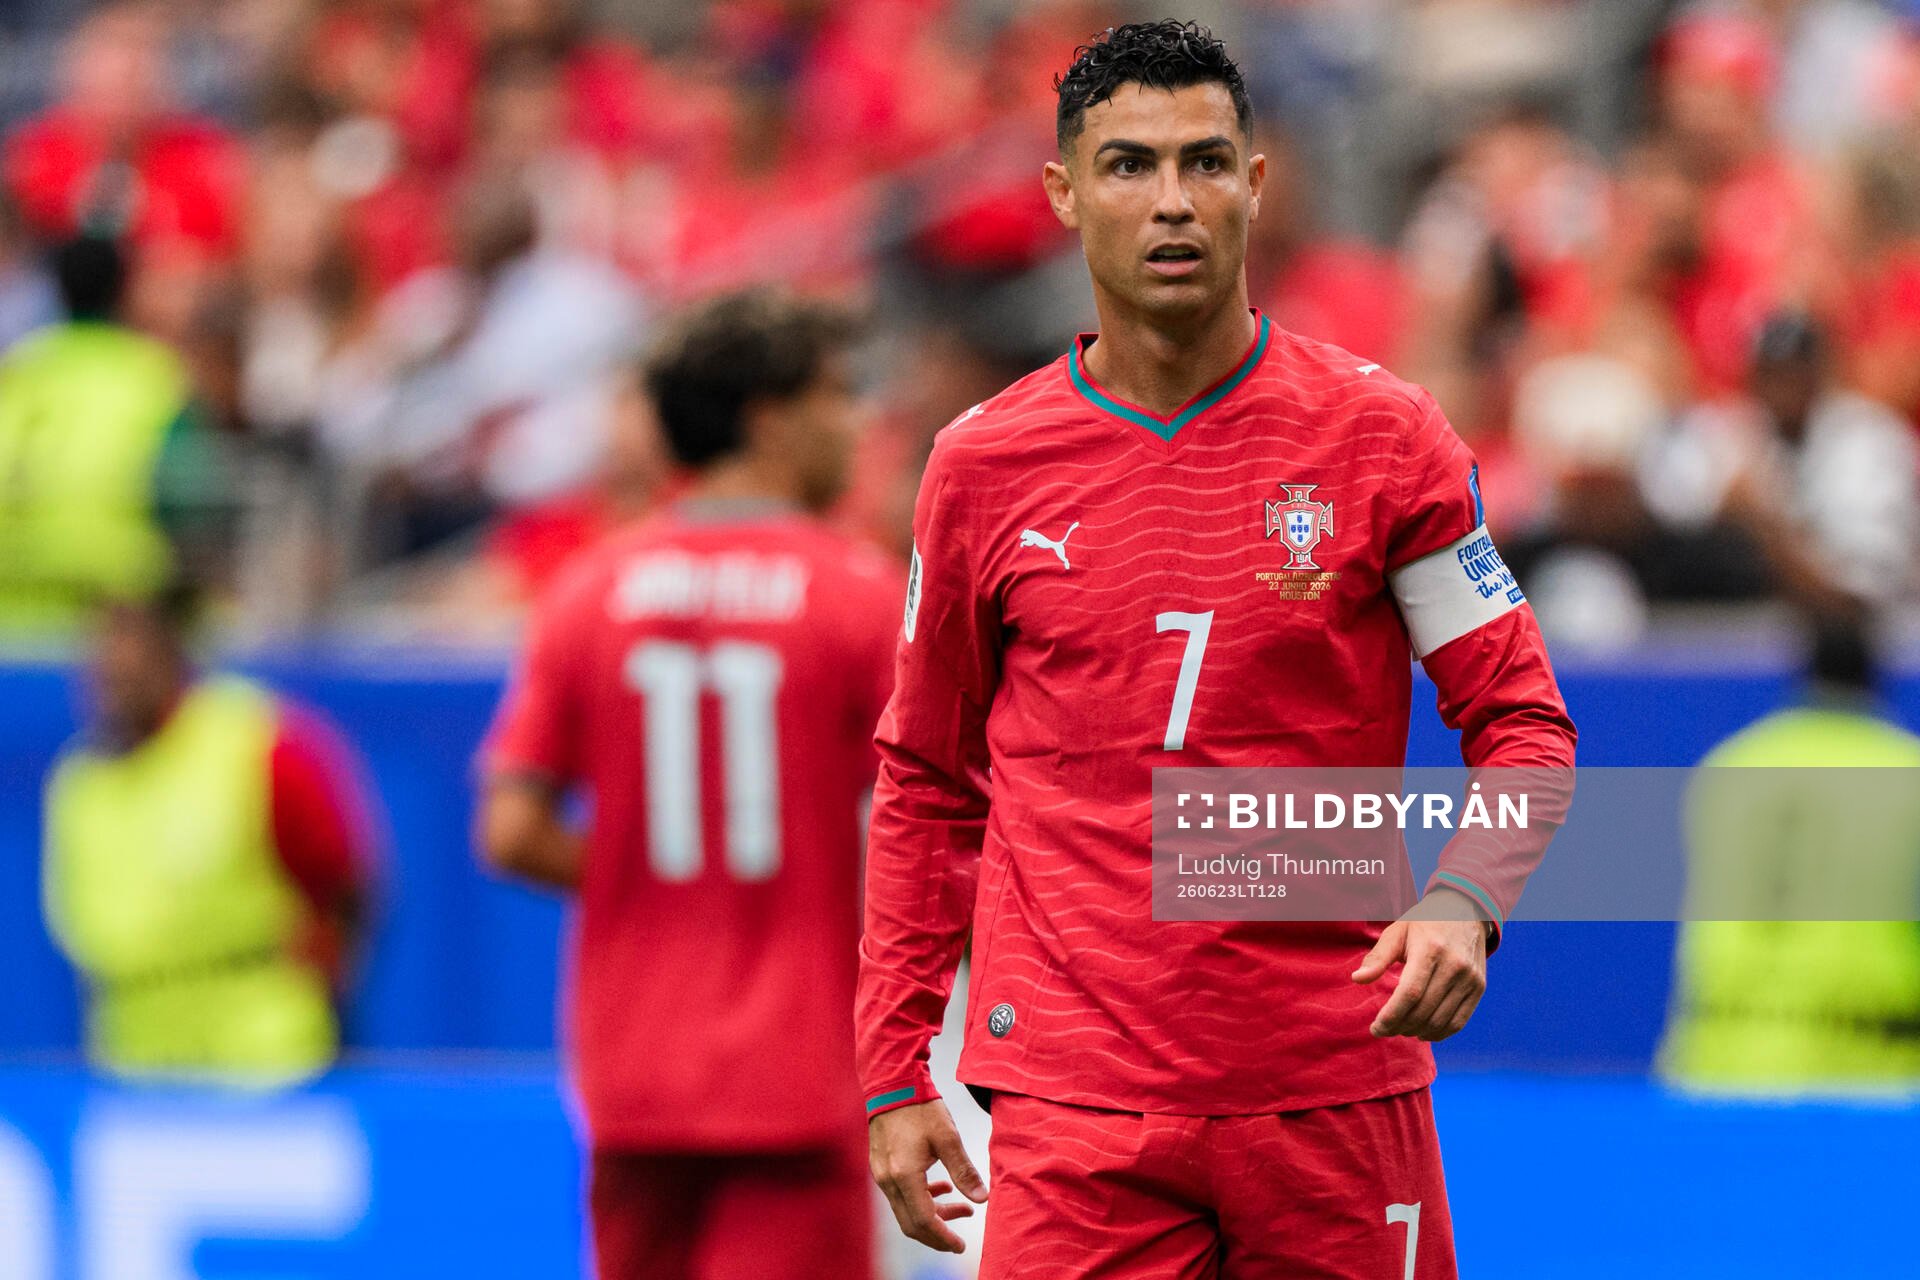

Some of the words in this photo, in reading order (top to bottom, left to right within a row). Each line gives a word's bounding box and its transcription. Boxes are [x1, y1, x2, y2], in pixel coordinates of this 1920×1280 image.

[1463, 550, 1504, 581] UNITE
[1268, 581, 1279, 591] 23
[1281, 582, 1307, 591] JUNHO
[1310, 582, 1331, 591] 2026
[1279, 591, 1321, 601] HOUSTON
[1475, 581, 1502, 599] the
[1155, 609, 1215, 750] 7
[623, 641, 782, 882] 11
[1385, 1201, 1421, 1280] 7
